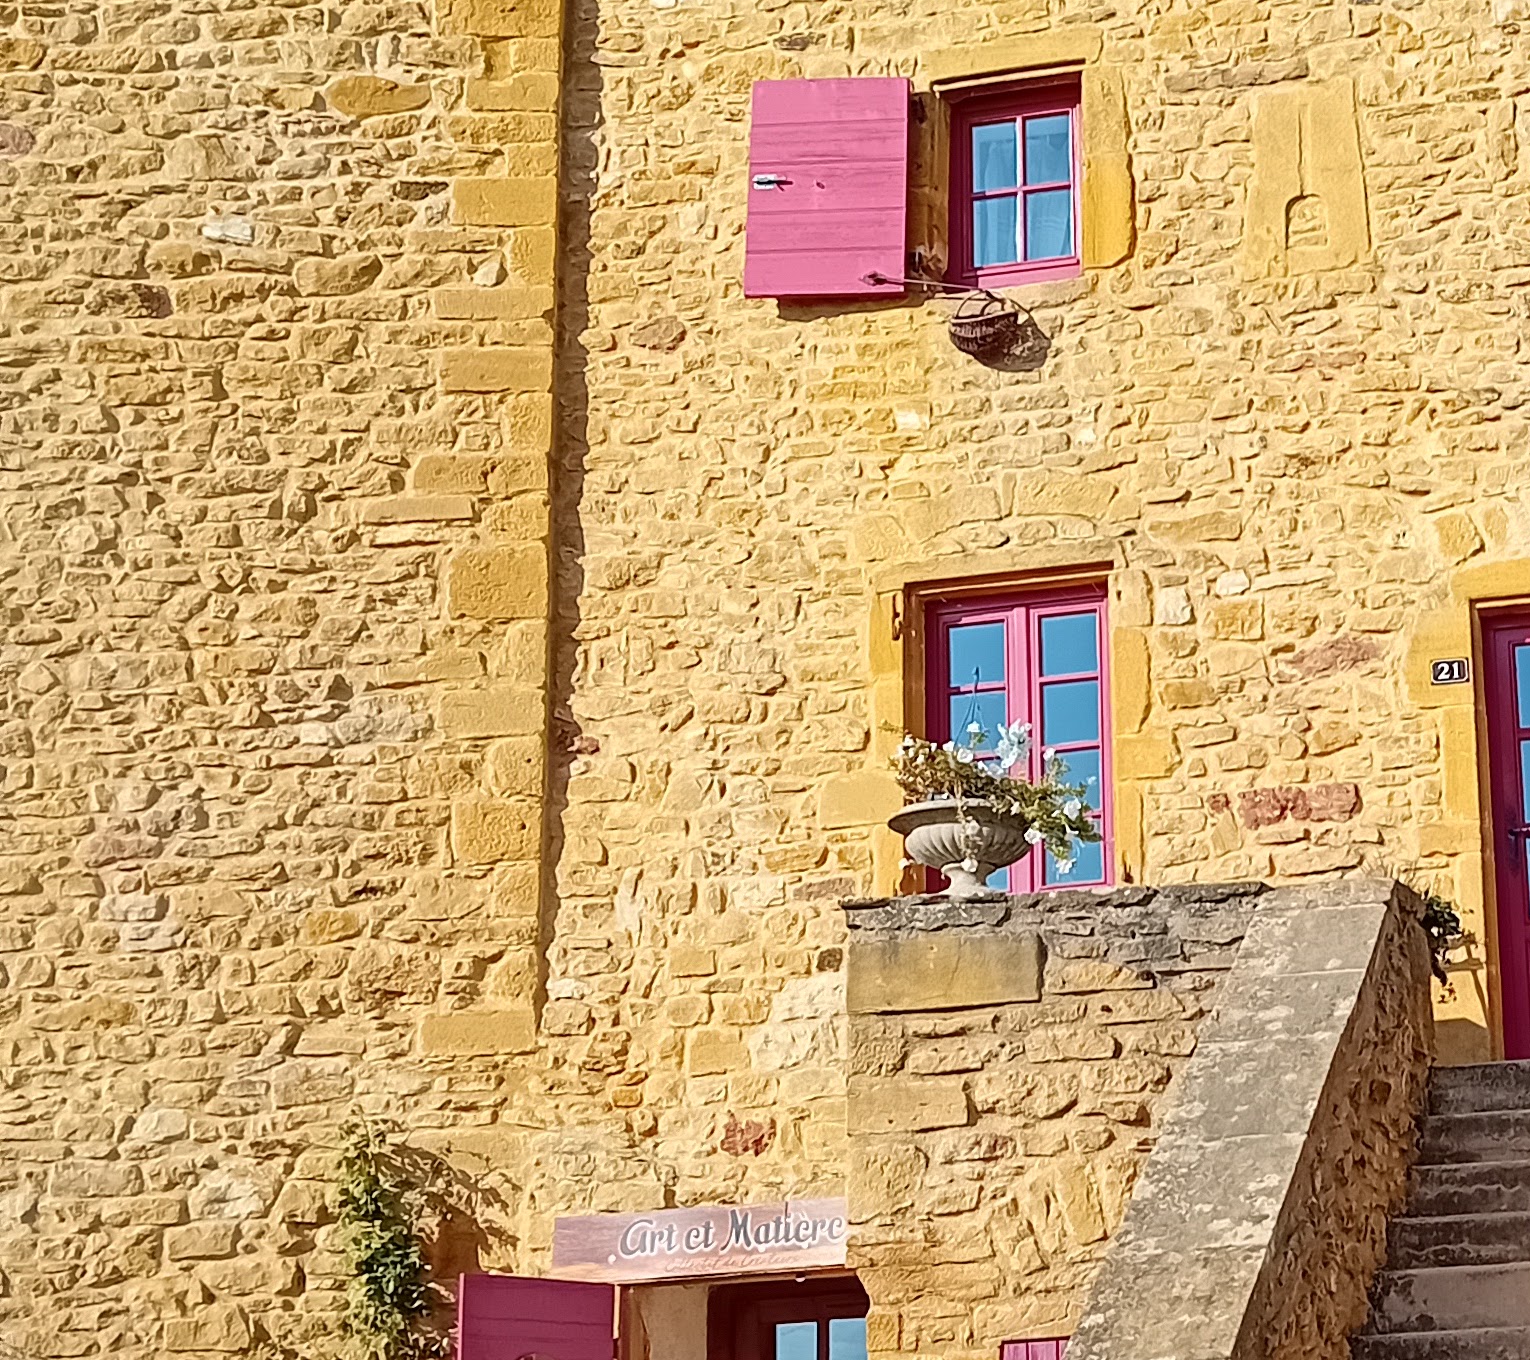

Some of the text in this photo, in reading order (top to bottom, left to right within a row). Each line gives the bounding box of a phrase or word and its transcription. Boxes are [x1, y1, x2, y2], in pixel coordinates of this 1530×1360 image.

[1437, 662, 1460, 680] 21
[620, 1208, 845, 1257] Art et Matière
